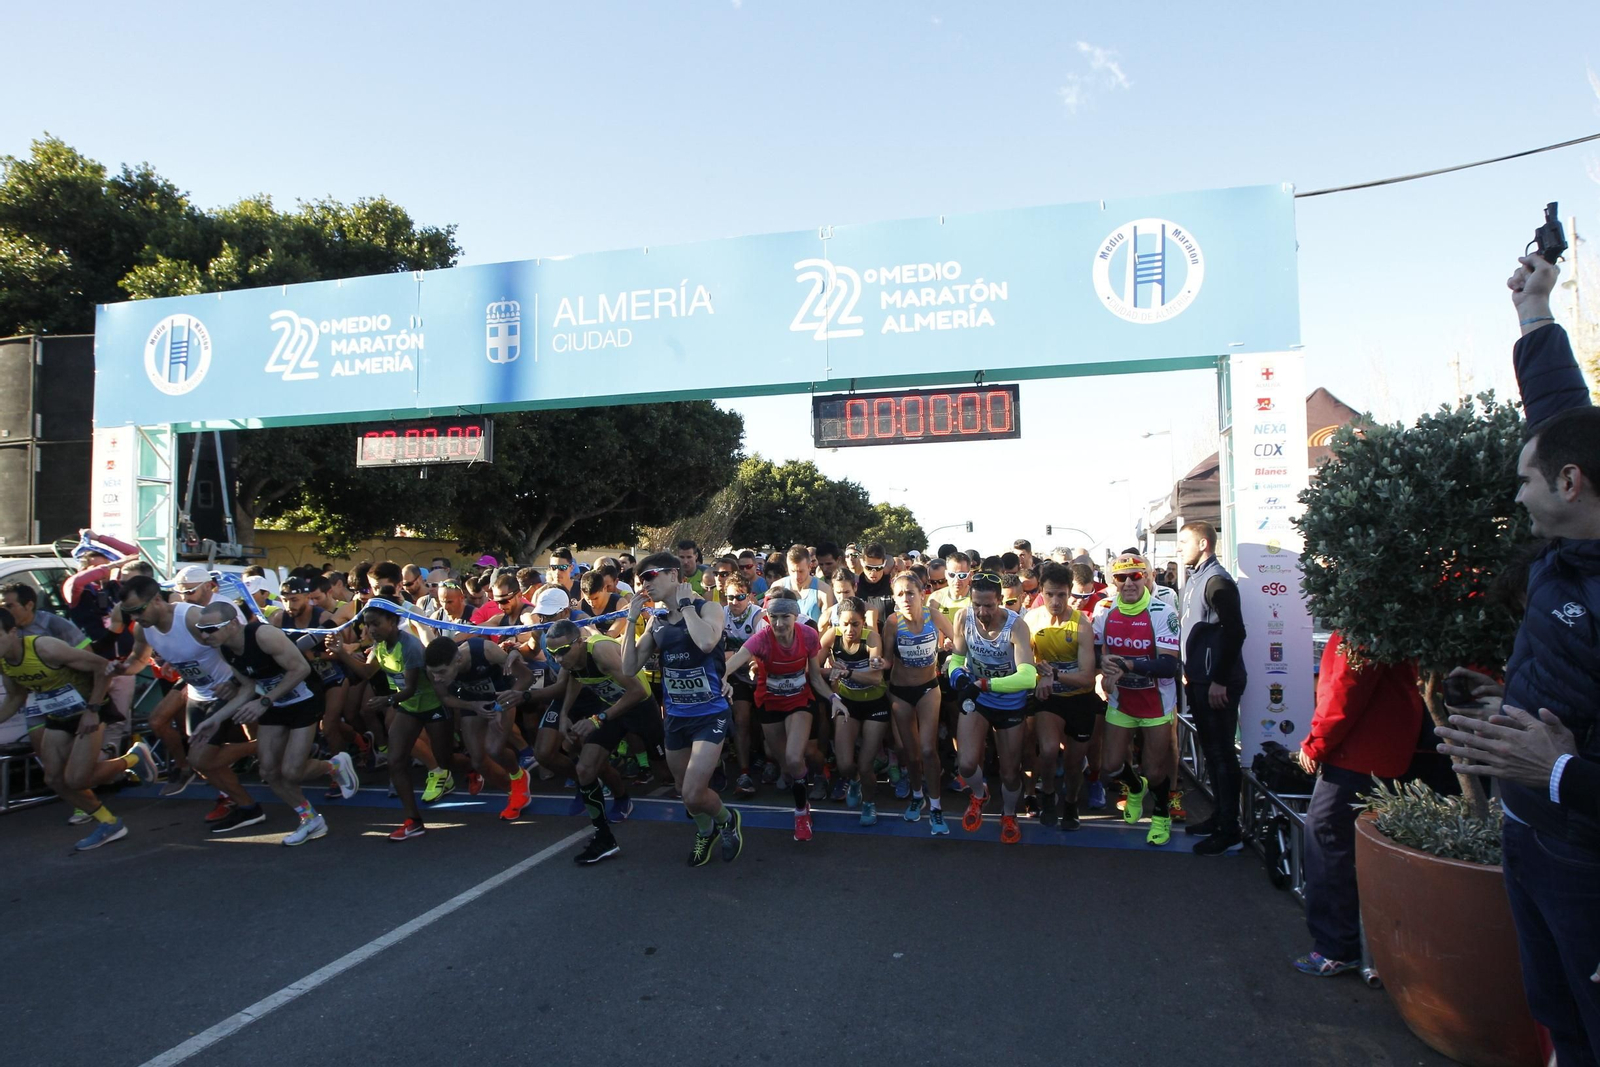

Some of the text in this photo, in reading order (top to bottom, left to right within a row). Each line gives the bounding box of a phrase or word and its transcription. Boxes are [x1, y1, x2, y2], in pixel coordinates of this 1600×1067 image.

[1099, 232, 1125, 260] Medio
[879, 260, 962, 286] MEDIO
[553, 279, 715, 327] ALMERÍA
[880, 278, 1008, 310] MARATÓN
[331, 314, 392, 335] MEDIO
[880, 303, 996, 335] ALMERÍA
[330, 330, 425, 356] MARATÓN
[552, 328, 633, 353] CIUDAD
[330, 350, 414, 377] ALMERÍA
[1253, 423, 1287, 435] NEXA
[1253, 443, 1284, 457] CDX
[1254, 468, 1288, 476] Blanes
[1261, 582, 1288, 596] ego
[669, 677, 704, 690] 2300
[977, 666, 1009, 678] 1847
